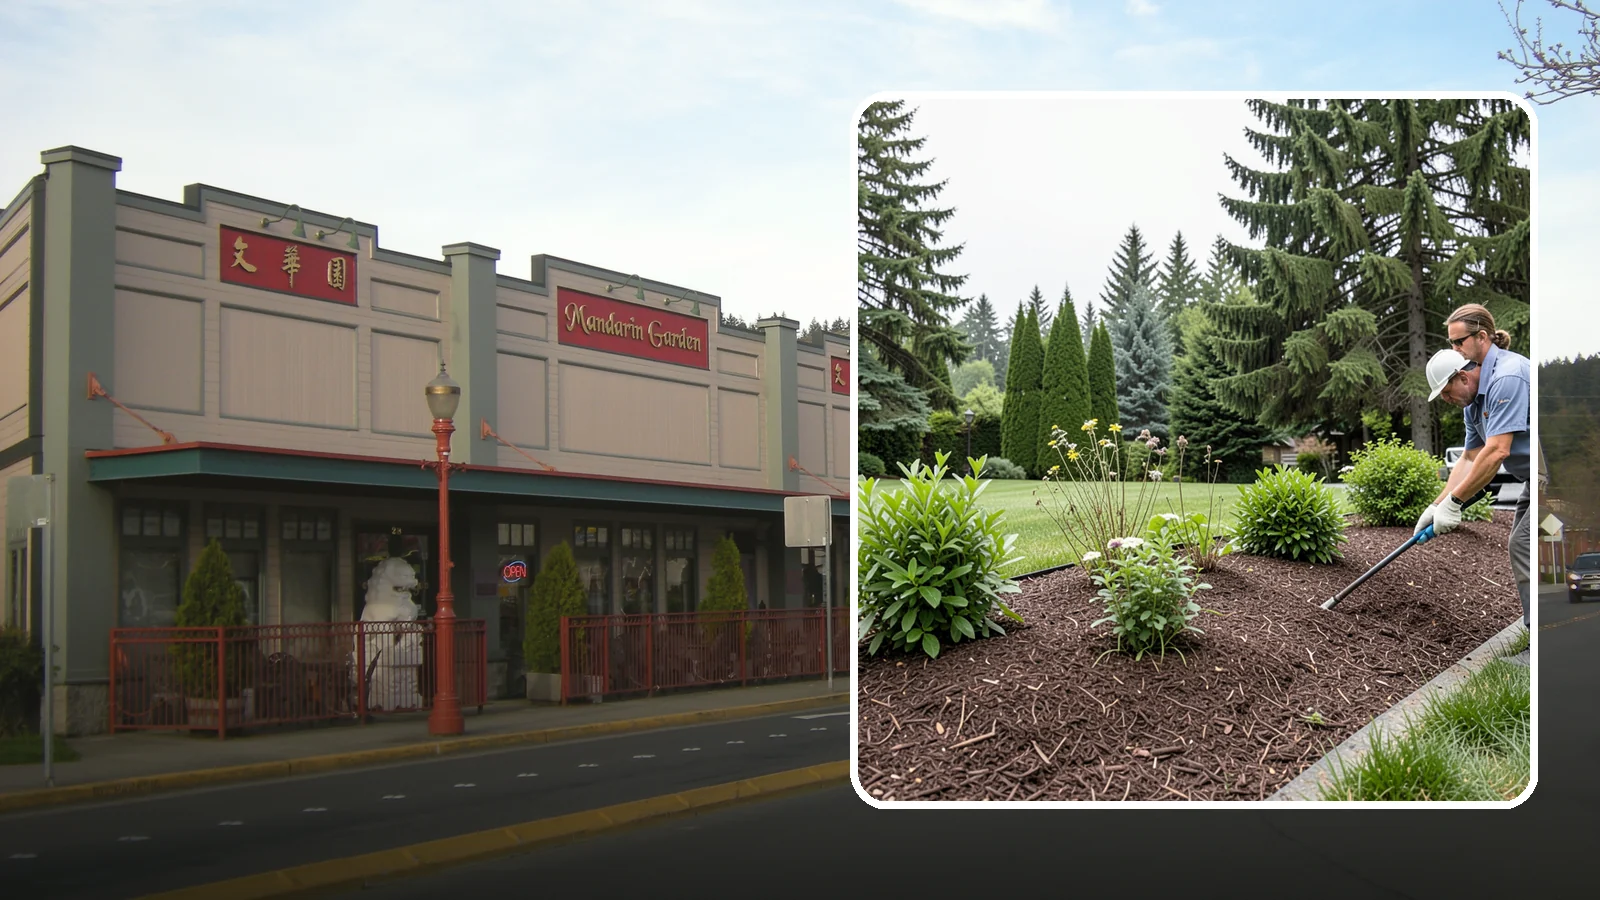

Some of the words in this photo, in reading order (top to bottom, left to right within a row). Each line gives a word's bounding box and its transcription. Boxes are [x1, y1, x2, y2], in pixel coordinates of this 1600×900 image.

[230, 235, 346, 291] 文華園
[564, 302, 644, 341] Mandarin
[648, 320, 701, 352] Garden
[503, 565, 527, 578] OPEN
